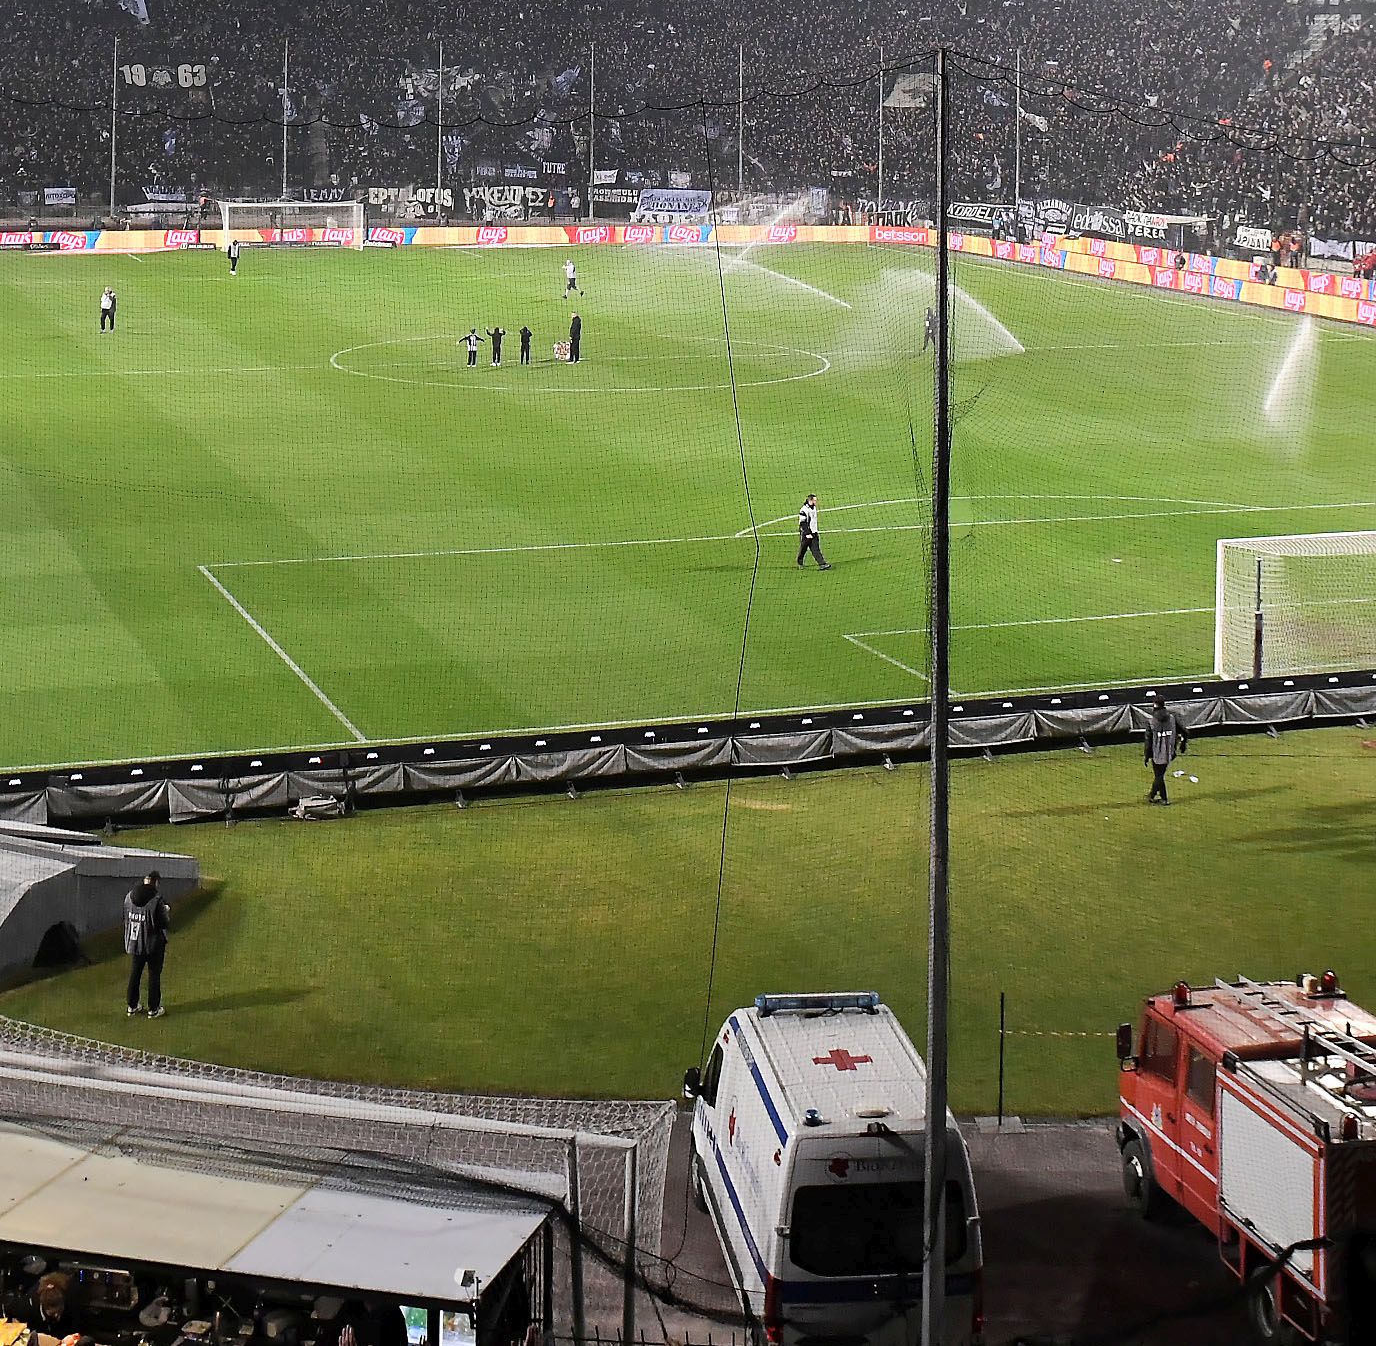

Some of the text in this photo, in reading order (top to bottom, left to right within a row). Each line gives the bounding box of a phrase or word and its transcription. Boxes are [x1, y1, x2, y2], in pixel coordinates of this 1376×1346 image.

[119, 63, 207, 88] 19 63
[875, 228, 926, 242] betsson
[1127, 224, 1166, 240] PEREA
